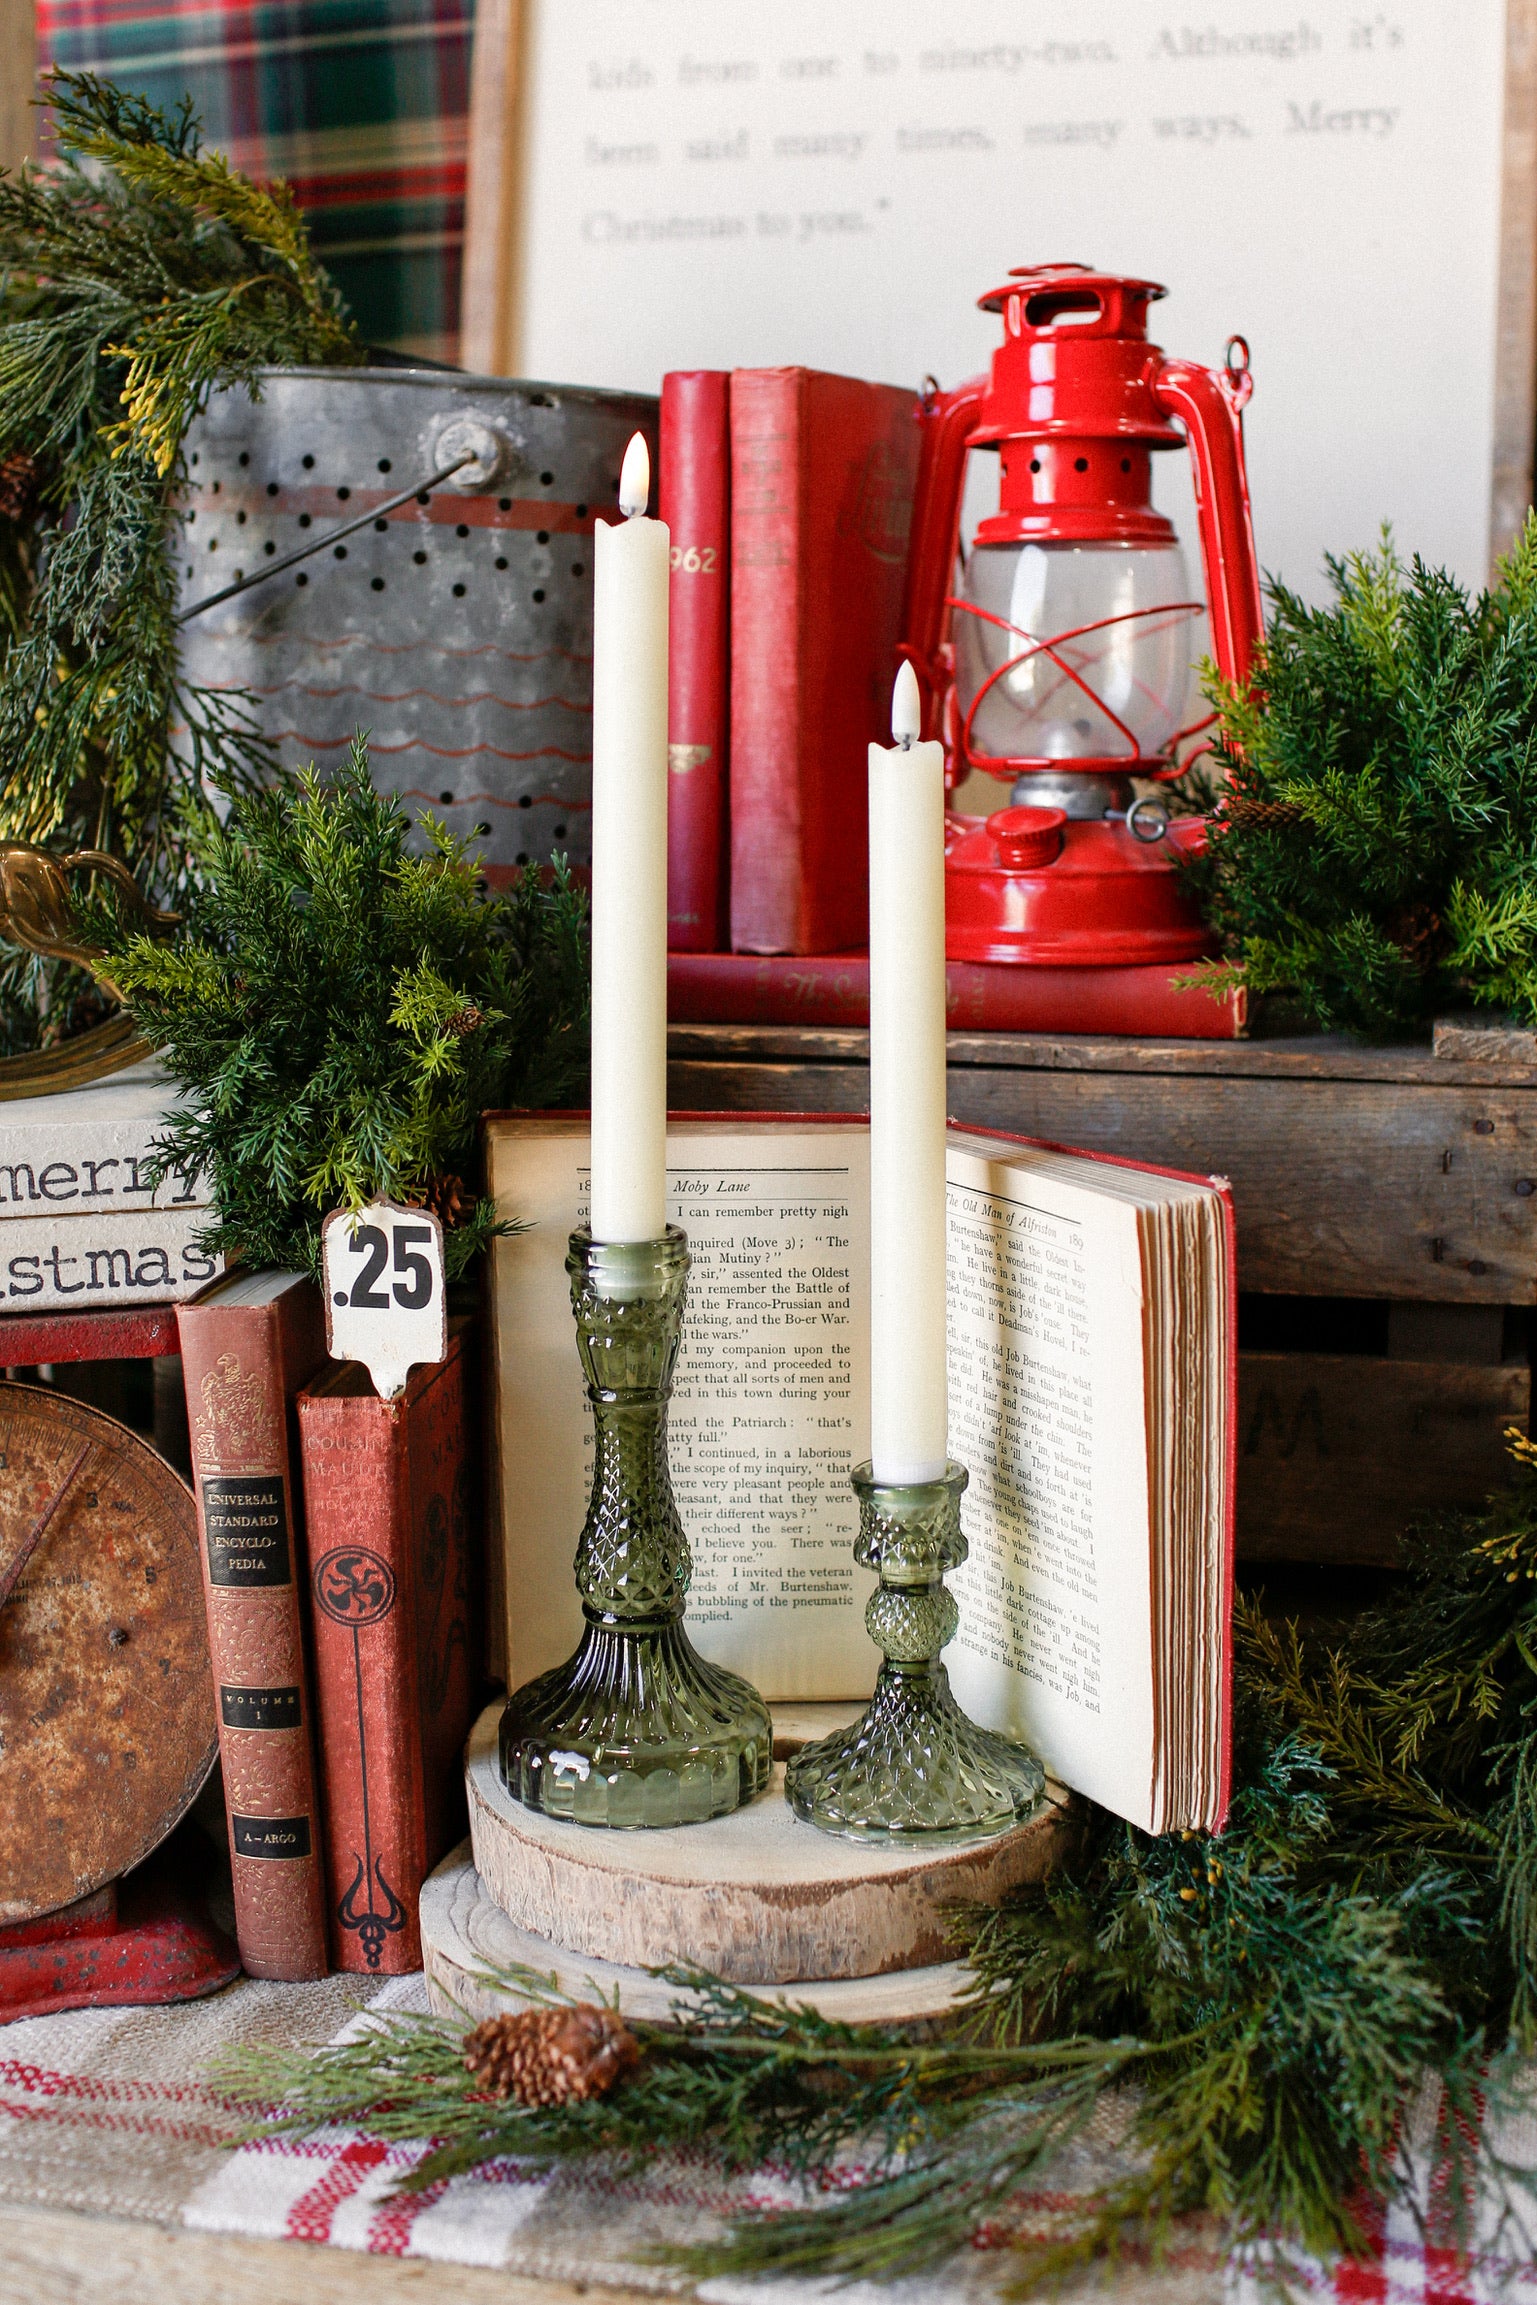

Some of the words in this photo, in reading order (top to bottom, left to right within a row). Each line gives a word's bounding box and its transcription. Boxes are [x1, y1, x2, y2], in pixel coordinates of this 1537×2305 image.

[1285, 100, 1398, 138] Merry
[673, 1180, 709, 1195] Moby
[716, 1181, 750, 1192] Lane
[689, 1209, 709, 1217] can
[716, 1206, 774, 1216] remember
[780, 1207, 816, 1219] pretty
[823, 1206, 848, 1219] nigh
[963, 1199, 977, 1212] Old
[982, 1204, 1002, 1220] Man
[1006, 1212, 1015, 1226] of
[1019, 1217, 1057, 1238] Alfriston
[742, 1237, 777, 1250] (Move
[1008, 1238, 1024, 1252] said
[0, 1243, 216, 1298] stmas
[333, 1225, 432, 1310] .25
[1006, 1255, 1042, 1274] wonderful
[733, 1268, 782, 1278] assented
[788, 1268, 806, 1278] the
[812, 1267, 849, 1278] Oldest
[708, 1283, 766, 1294] remember
[772, 1283, 790, 1293] the
[796, 1283, 833, 1293] Battle
[838, 1282, 850, 1293] of
[1007, 1287, 1026, 1300] aside
[702, 1299, 720, 1309] the
[727, 1298, 822, 1309] Franco-Prussian
[828, 1298, 850, 1308] and
[736, 1314, 758, 1324] and
[762, 1314, 780, 1324] the
[785, 1314, 817, 1324] Bo-er
[821, 1313, 849, 1324] War.
[998, 1313, 1039, 1338] Deadman's
[691, 1329, 709, 1339] the
[696, 1347, 714, 1357] my
[723, 1344, 786, 1357] companion
[794, 1347, 823, 1357] upon
[832, 1344, 850, 1354] the
[1006, 1348, 1020, 1362] Job
[687, 1362, 737, 1371] memory,
[745, 1359, 766, 1368] and
[774, 1358, 832, 1371] proceeded
[839, 1360, 851, 1368] to
[1005, 1363, 1024, 1380] lived
[670, 1373, 699, 1387] xpect
[705, 1374, 728, 1383] that
[733, 1373, 747, 1383] all
[752, 1375, 780, 1383] sorts
[784, 1373, 795, 1383] of
[829, 1373, 850, 1383] and
[698, 1388, 708, 1397] in
[716, 1388, 737, 1397] this
[744, 1389, 772, 1398] town
[779, 1388, 817, 1400] during
[824, 1391, 851, 1400] your
[1022, 1404, 1050, 1424] crooked
[706, 1417, 724, 1427] the
[1006, 1415, 1028, 1430] under
[699, 1448, 759, 1459] continued,
[766, 1448, 776, 1458] in
[799, 1447, 851, 1458] laborious
[672, 1462, 690, 1472] the
[694, 1465, 725, 1476] scope
[729, 1463, 740, 1473] of
[744, 1466, 762, 1476] my
[766, 1463, 812, 1476] inquiry,
[670, 1478, 696, 1490] were
[702, 1481, 728, 1491] very
[734, 1478, 781, 1491] pleasant
[788, 1478, 824, 1491] people
[830, 1476, 852, 1489] and
[208, 1493, 277, 1505] UNIVERSAL
[729, 1493, 751, 1503] and
[760, 1493, 783, 1503] that
[792, 1493, 817, 1506] they
[1016, 1484, 1057, 1508] schoolboys
[686, 1508, 712, 1518] their
[716, 1509, 765, 1519] different
[210, 1515, 278, 1527] STANDARD
[702, 1523, 740, 1533] echoed
[752, 1523, 770, 1533] the
[215, 1537, 276, 1548] ENCYCLO-
[705, 1538, 745, 1548] believe
[752, 1541, 776, 1551] you.
[791, 1538, 823, 1548] There
[713, 1552, 728, 1562] for
[228, 1559, 266, 1569] PEDIA
[693, 1566, 718, 1577] last.
[743, 1567, 782, 1577] invited
[787, 1568, 806, 1578] the
[810, 1568, 852, 1577] veteran
[728, 1582, 739, 1591] of
[750, 1582, 768, 1591] Mr.
[781, 1581, 852, 1592] Burtenshaw.
[1001, 1577, 1015, 1591] Job
[698, 1596, 748, 1609] bubbling
[753, 1596, 764, 1606] of
[770, 1596, 788, 1606] the
[793, 1595, 853, 1609] pneumatic
[684, 1610, 732, 1623] omplied.
[1007, 1596, 1024, 1613] dark
[1028, 1607, 1056, 1628] cottage
[1017, 1660, 1045, 1685] fancies,
[226, 1695, 294, 1704] VOLUME
